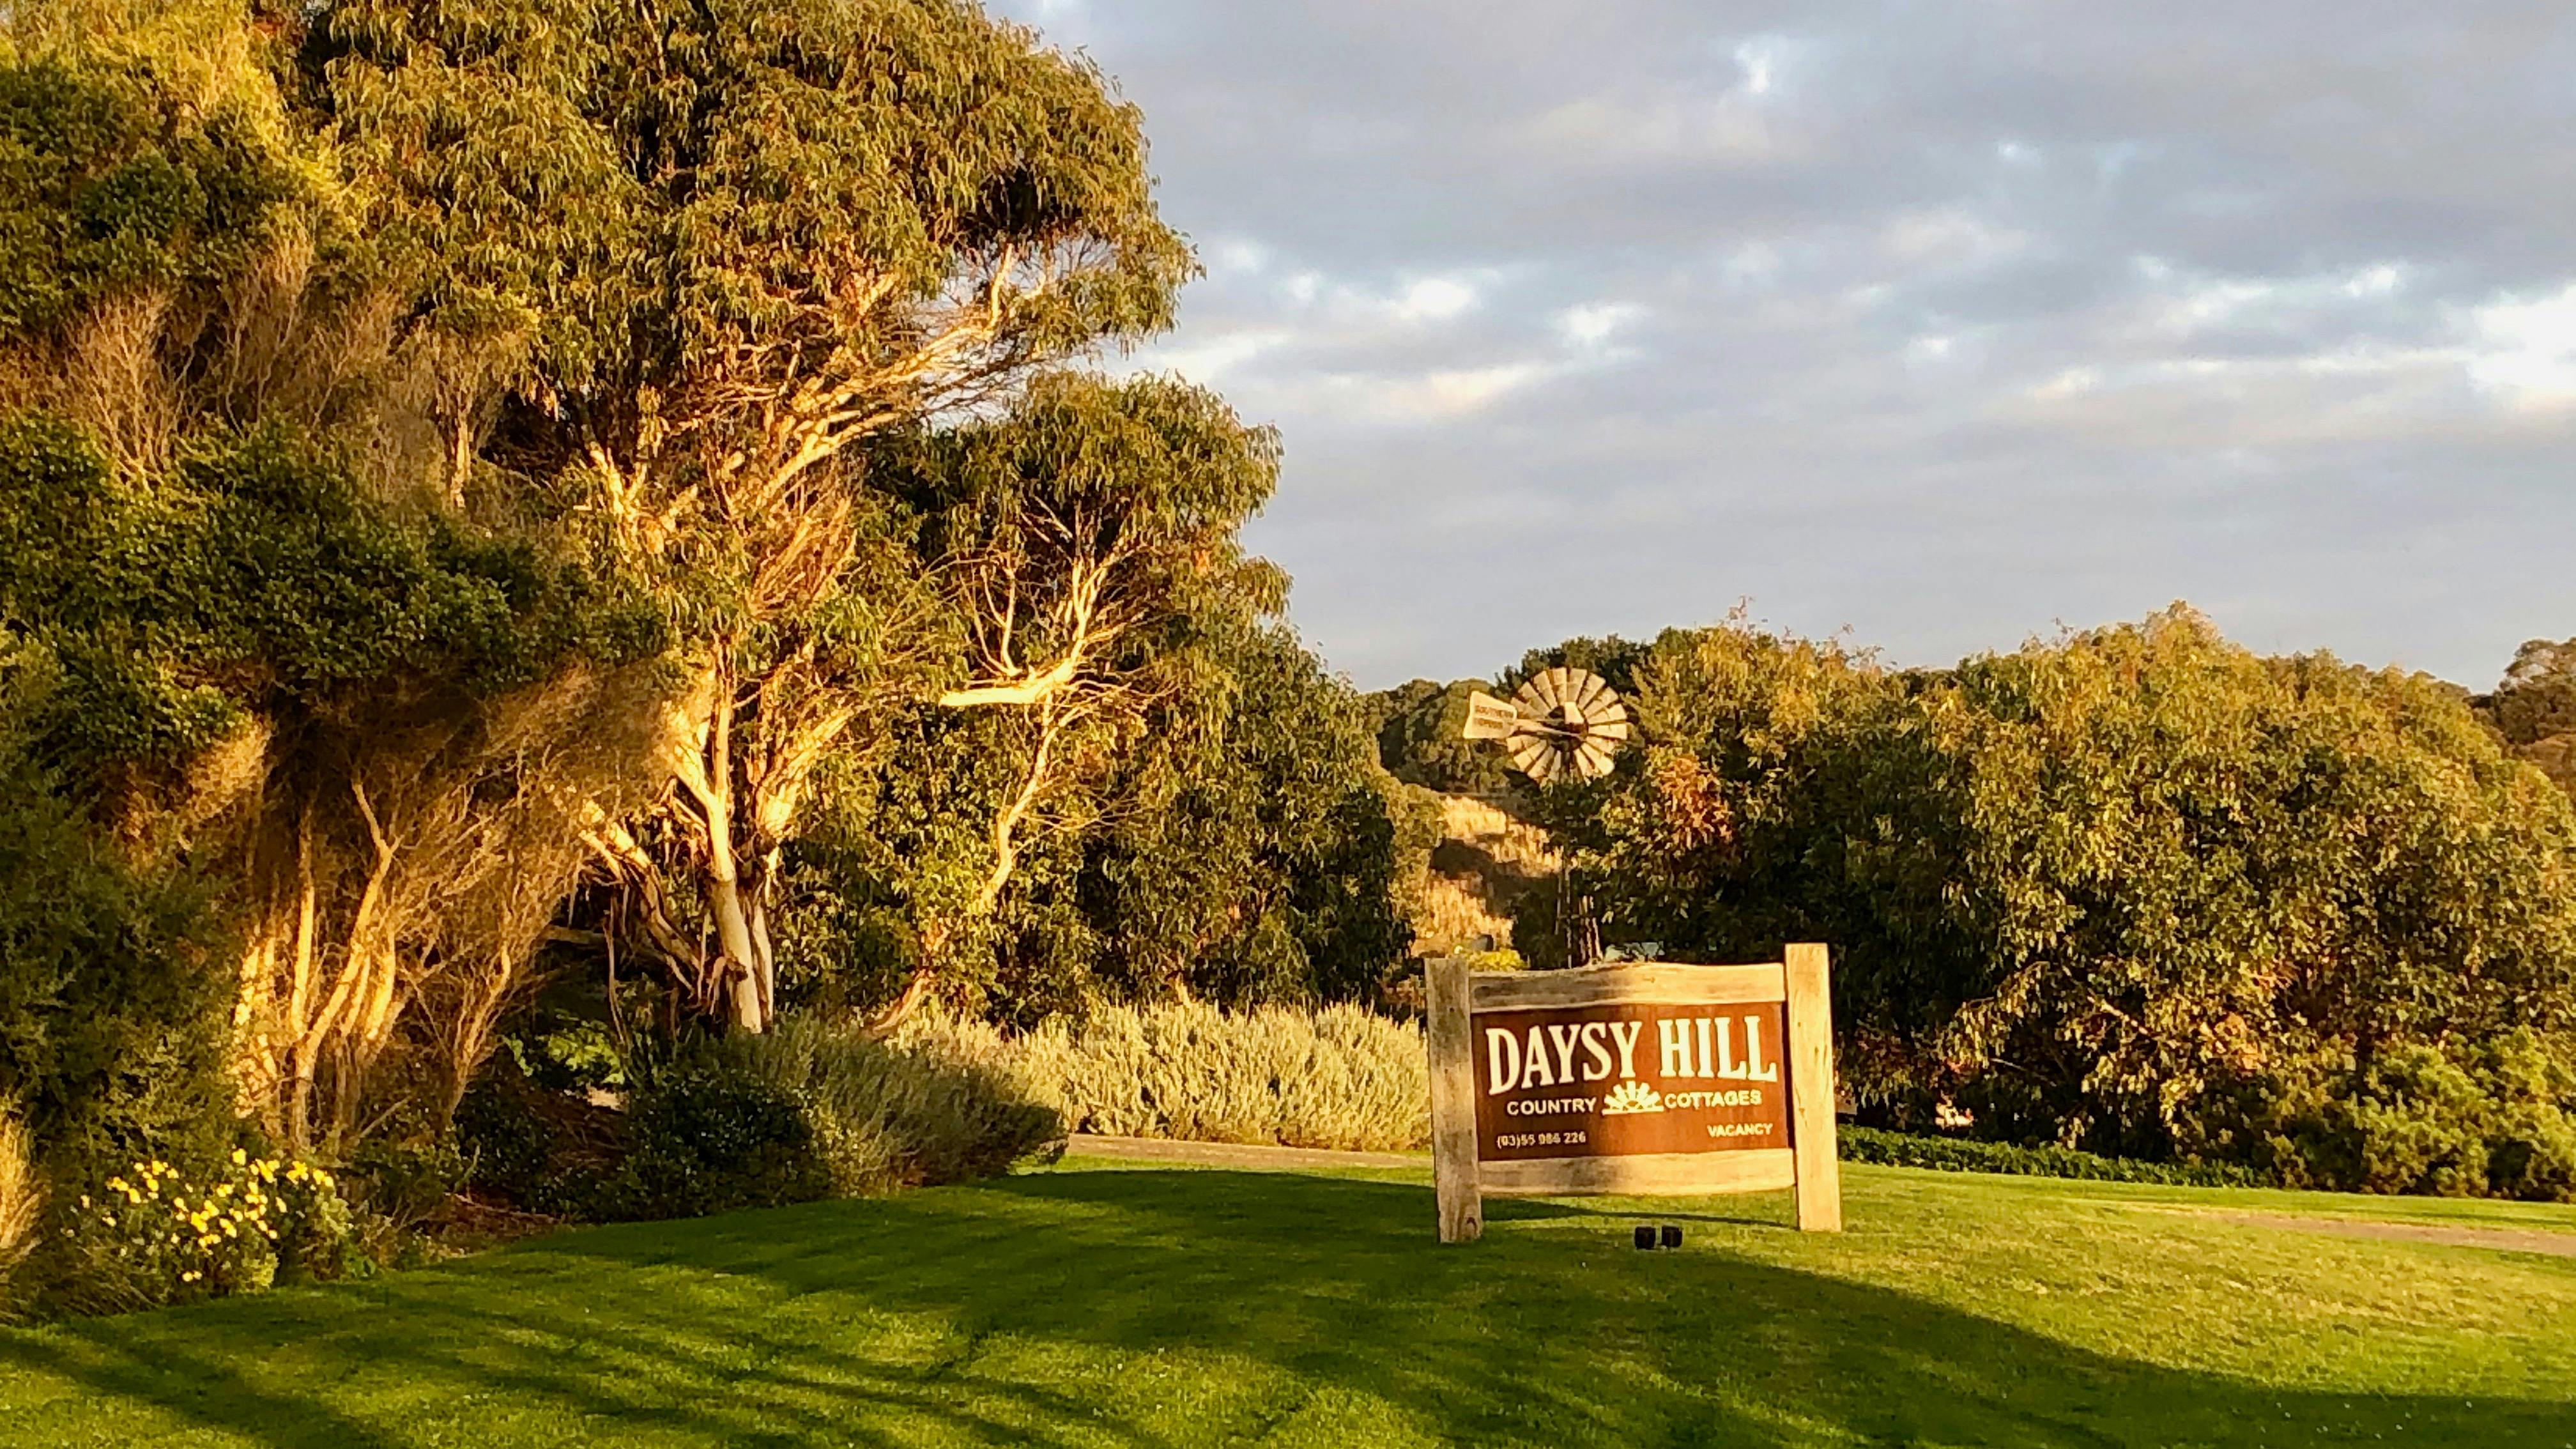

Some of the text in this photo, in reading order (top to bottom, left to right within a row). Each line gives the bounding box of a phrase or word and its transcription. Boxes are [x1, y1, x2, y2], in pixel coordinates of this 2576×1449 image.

[1485, 1016, 1777, 1095] DAYSY HILL
[1507, 1089, 1762, 1115] COUNTRY COTTAGES
[1563, 1131, 1586, 1144] 226
[1707, 1123, 1773, 1137] VACANCY
